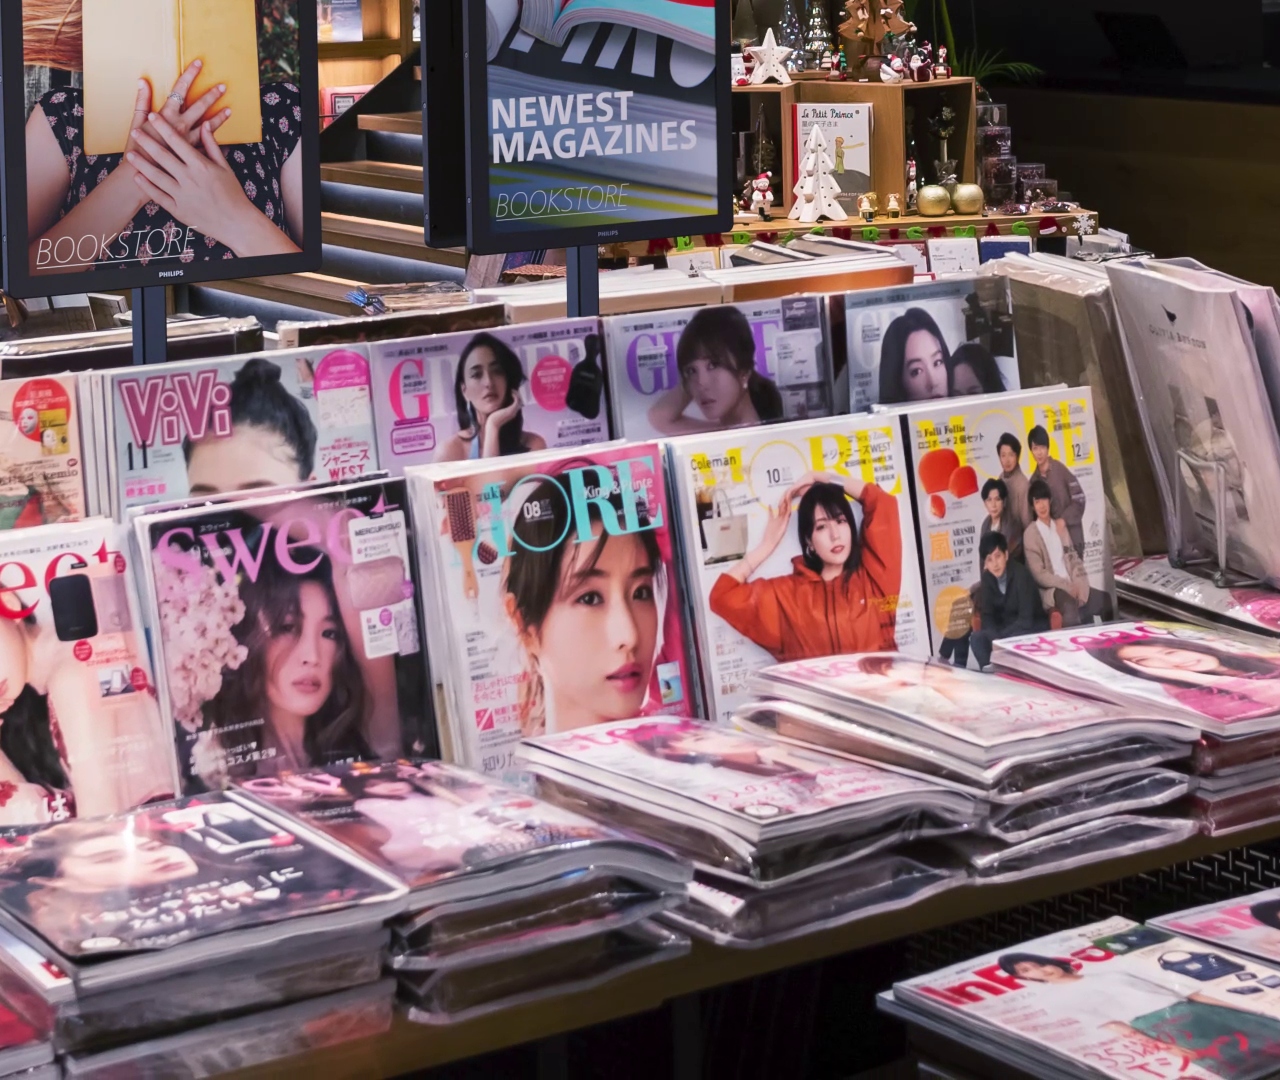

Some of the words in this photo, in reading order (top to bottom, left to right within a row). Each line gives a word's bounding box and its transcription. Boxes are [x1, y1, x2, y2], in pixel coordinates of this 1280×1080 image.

[492, 90, 634, 129] NEWEST
[801, 109, 809, 118] Le
[812, 109, 828, 118] Petit
[830, 109, 853, 118] Prince
[492, 120, 698, 164] MAGAZINES
[496, 183, 629, 218] BOOKSTORE
[597, 230, 619, 238] PHILIPS
[36, 225, 197, 266] BOOKSTORE
[158, 270, 184, 278] PHILIPS
[118, 369, 233, 448] ViVi
[944, 424, 966, 434] Follie
[1071, 443, 1082, 458] 12
[690, 454, 737, 471] Coleman
[767, 468, 781, 483] 10
[584, 484, 613, 500] King
[523, 500, 542, 519] 08
[928, 530, 953, 563] 嵐
